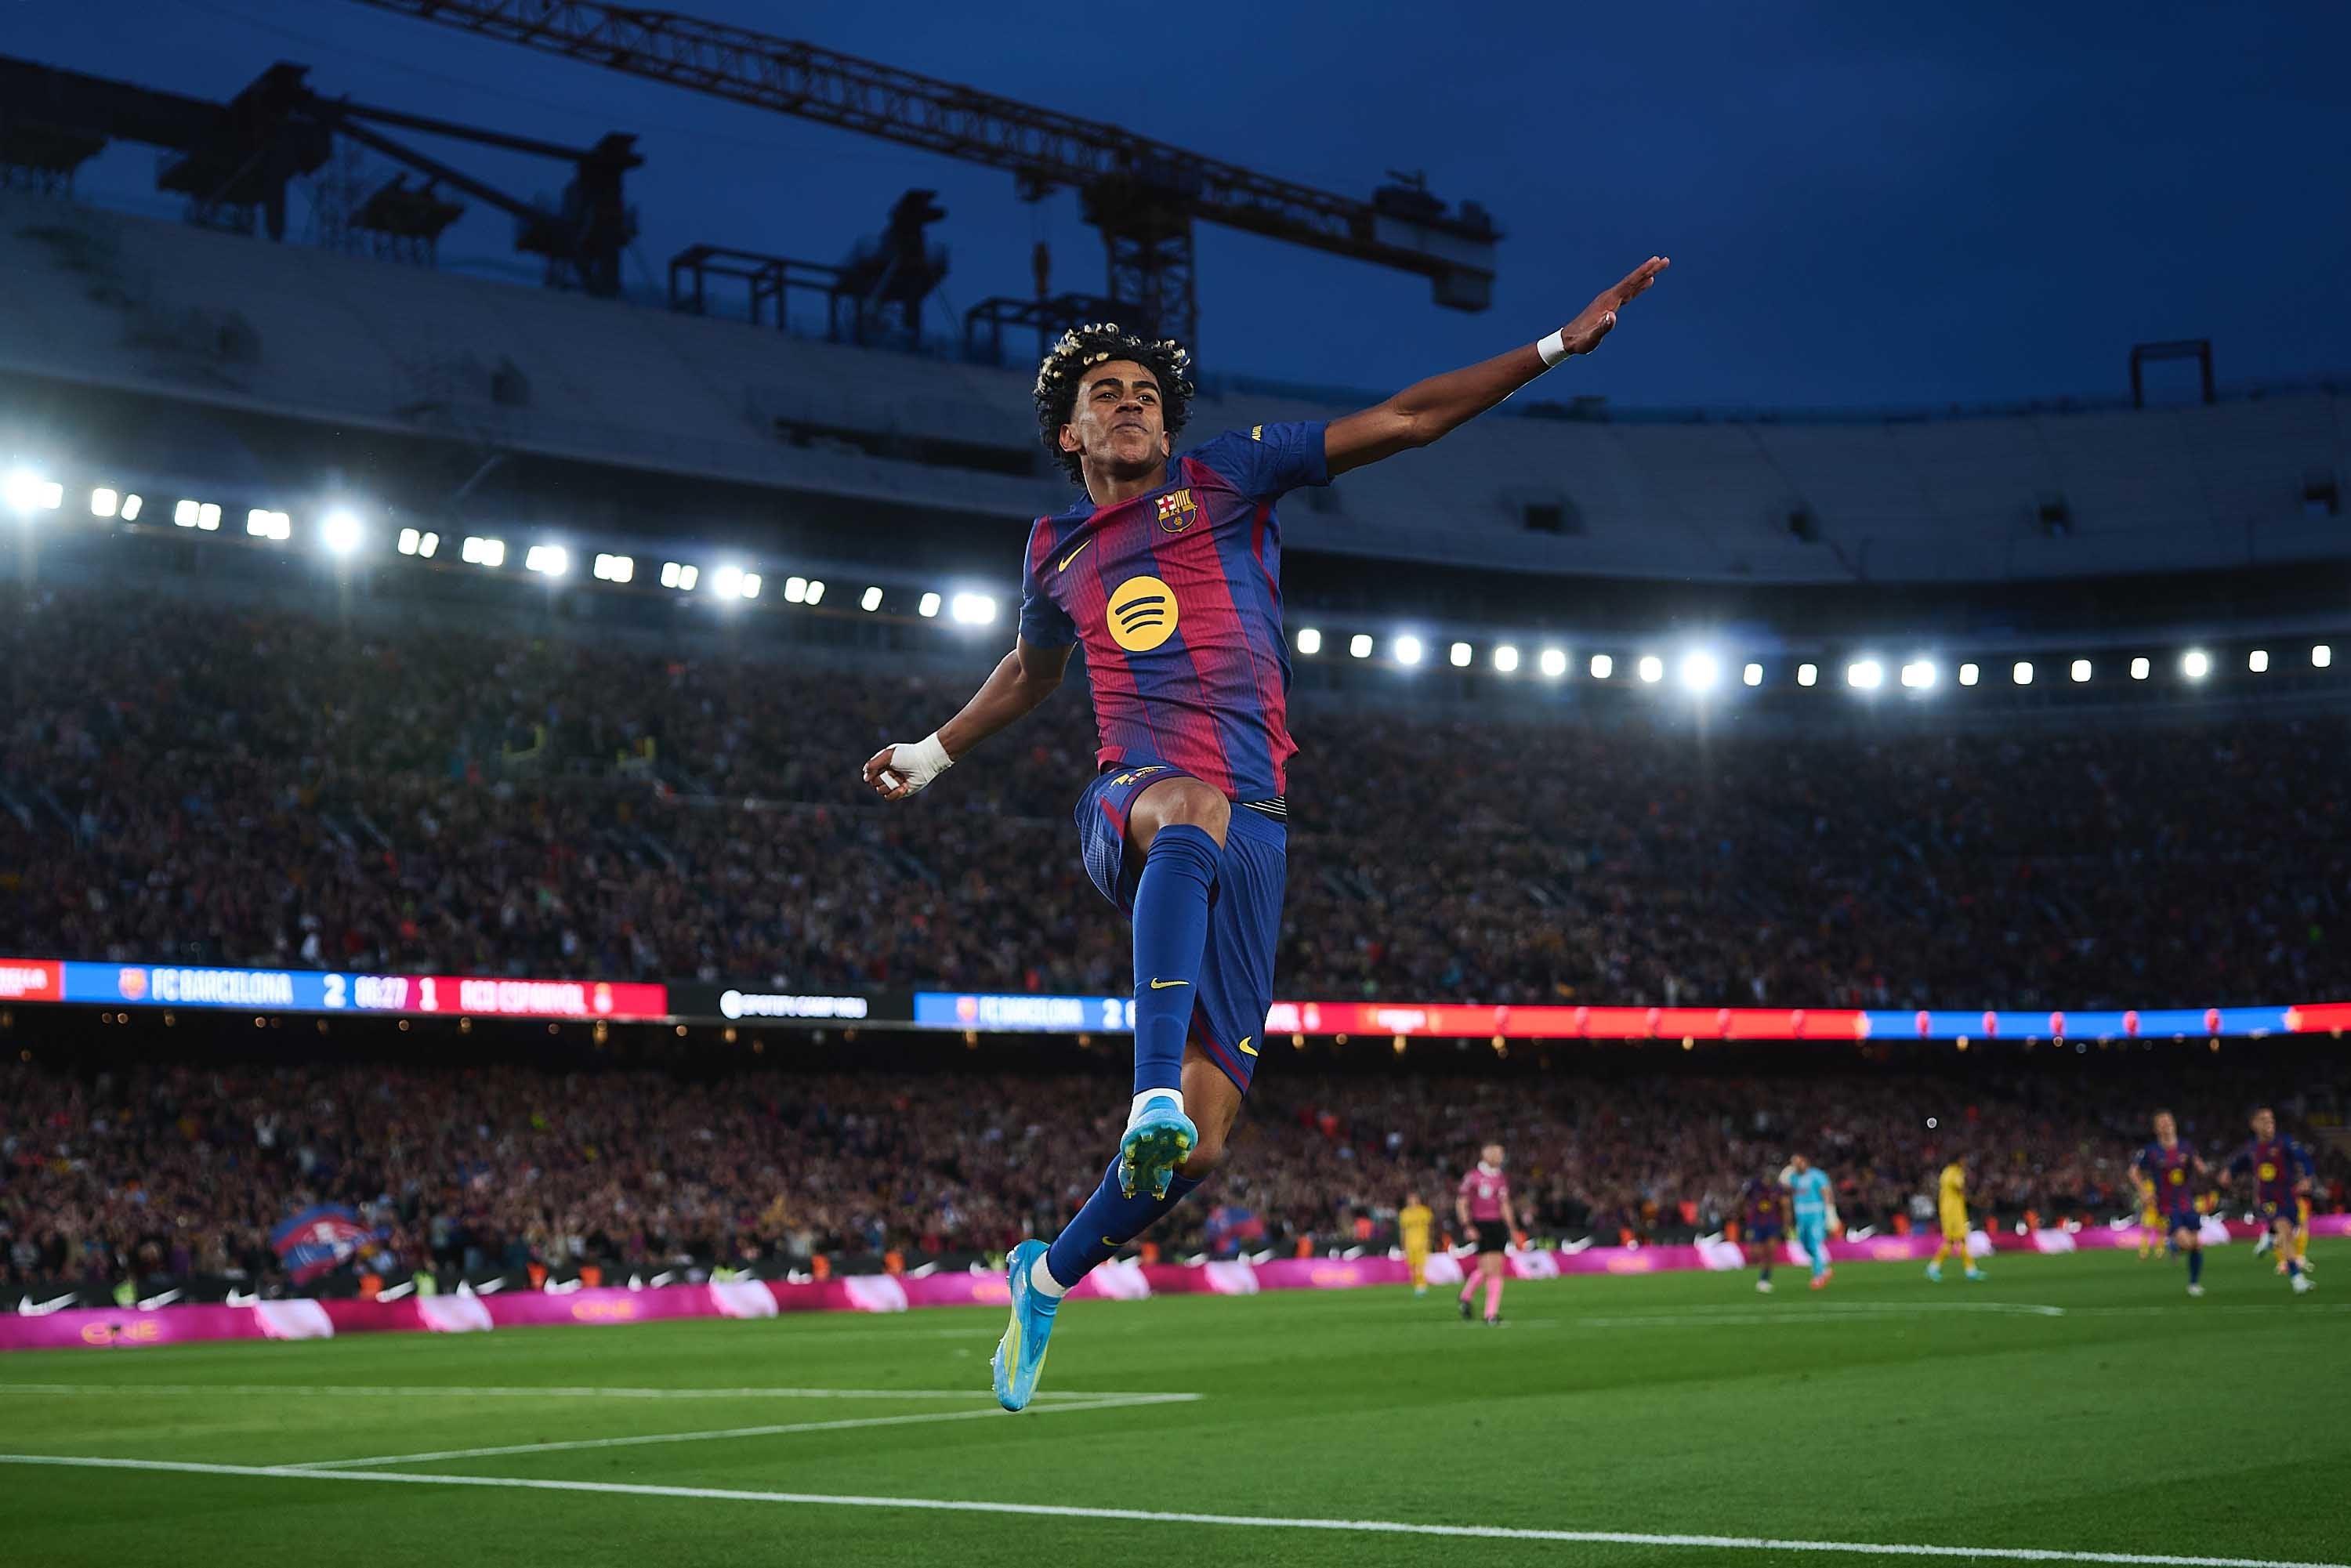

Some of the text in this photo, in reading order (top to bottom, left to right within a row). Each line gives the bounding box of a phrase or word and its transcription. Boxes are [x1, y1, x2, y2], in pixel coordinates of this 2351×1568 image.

[179, 969, 294, 1005] BARCELONA
[323, 973, 346, 1009] 2
[418, 977, 439, 1012] 1
[1103, 998, 1121, 1029] 2
